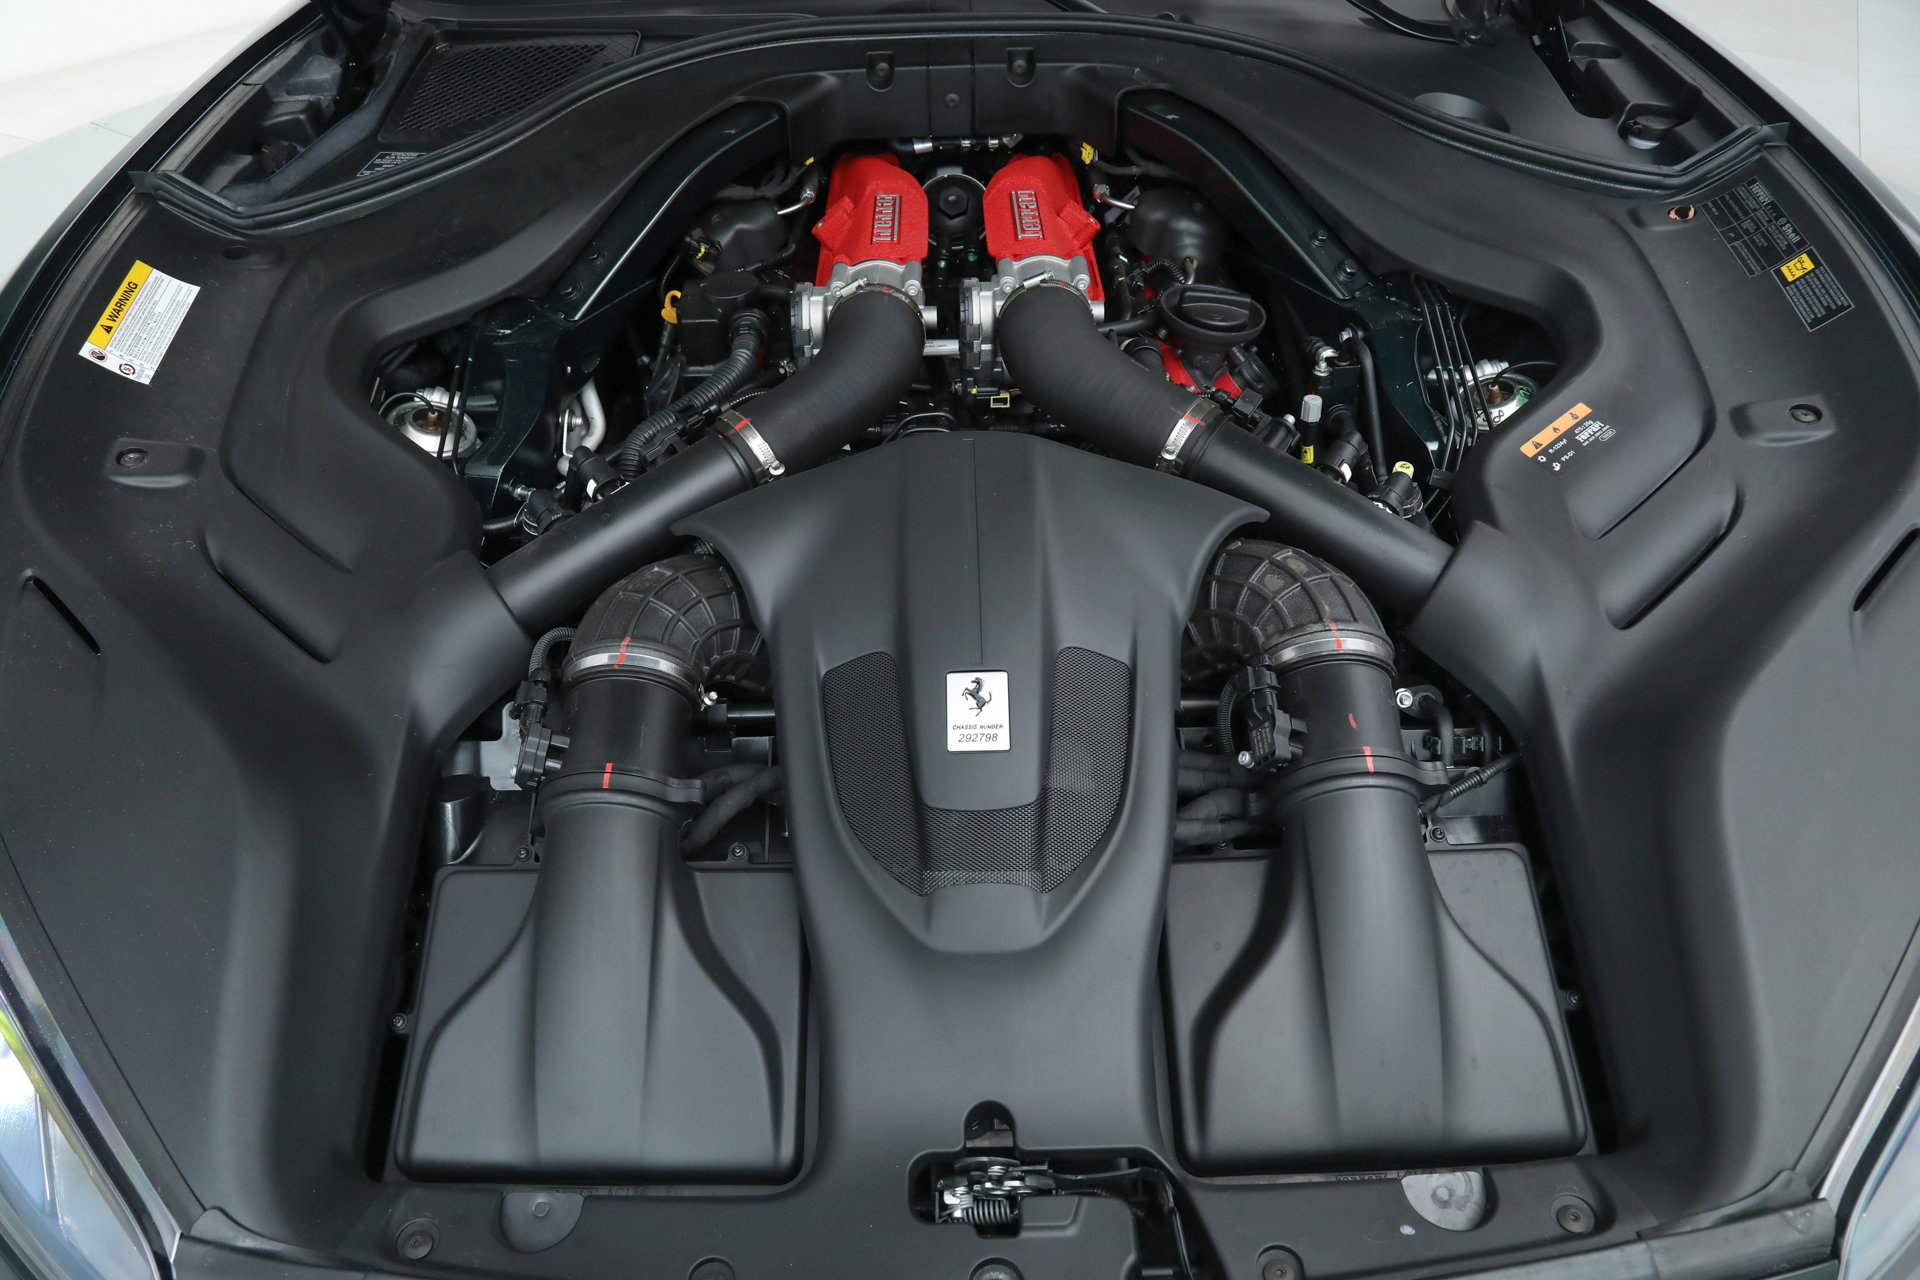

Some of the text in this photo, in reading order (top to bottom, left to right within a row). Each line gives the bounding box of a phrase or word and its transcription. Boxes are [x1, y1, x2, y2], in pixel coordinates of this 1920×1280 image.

[1750, 182, 1773, 205] Ferrari
[872, 193, 900, 243] Ferrari
[1011, 190, 1043, 239] Ferrari
[1782, 223, 1801, 243] Shell
[106, 281, 138, 322] WARNING
[1575, 420, 1605, 442] Ferrari
[957, 732, 999, 743] 292798
